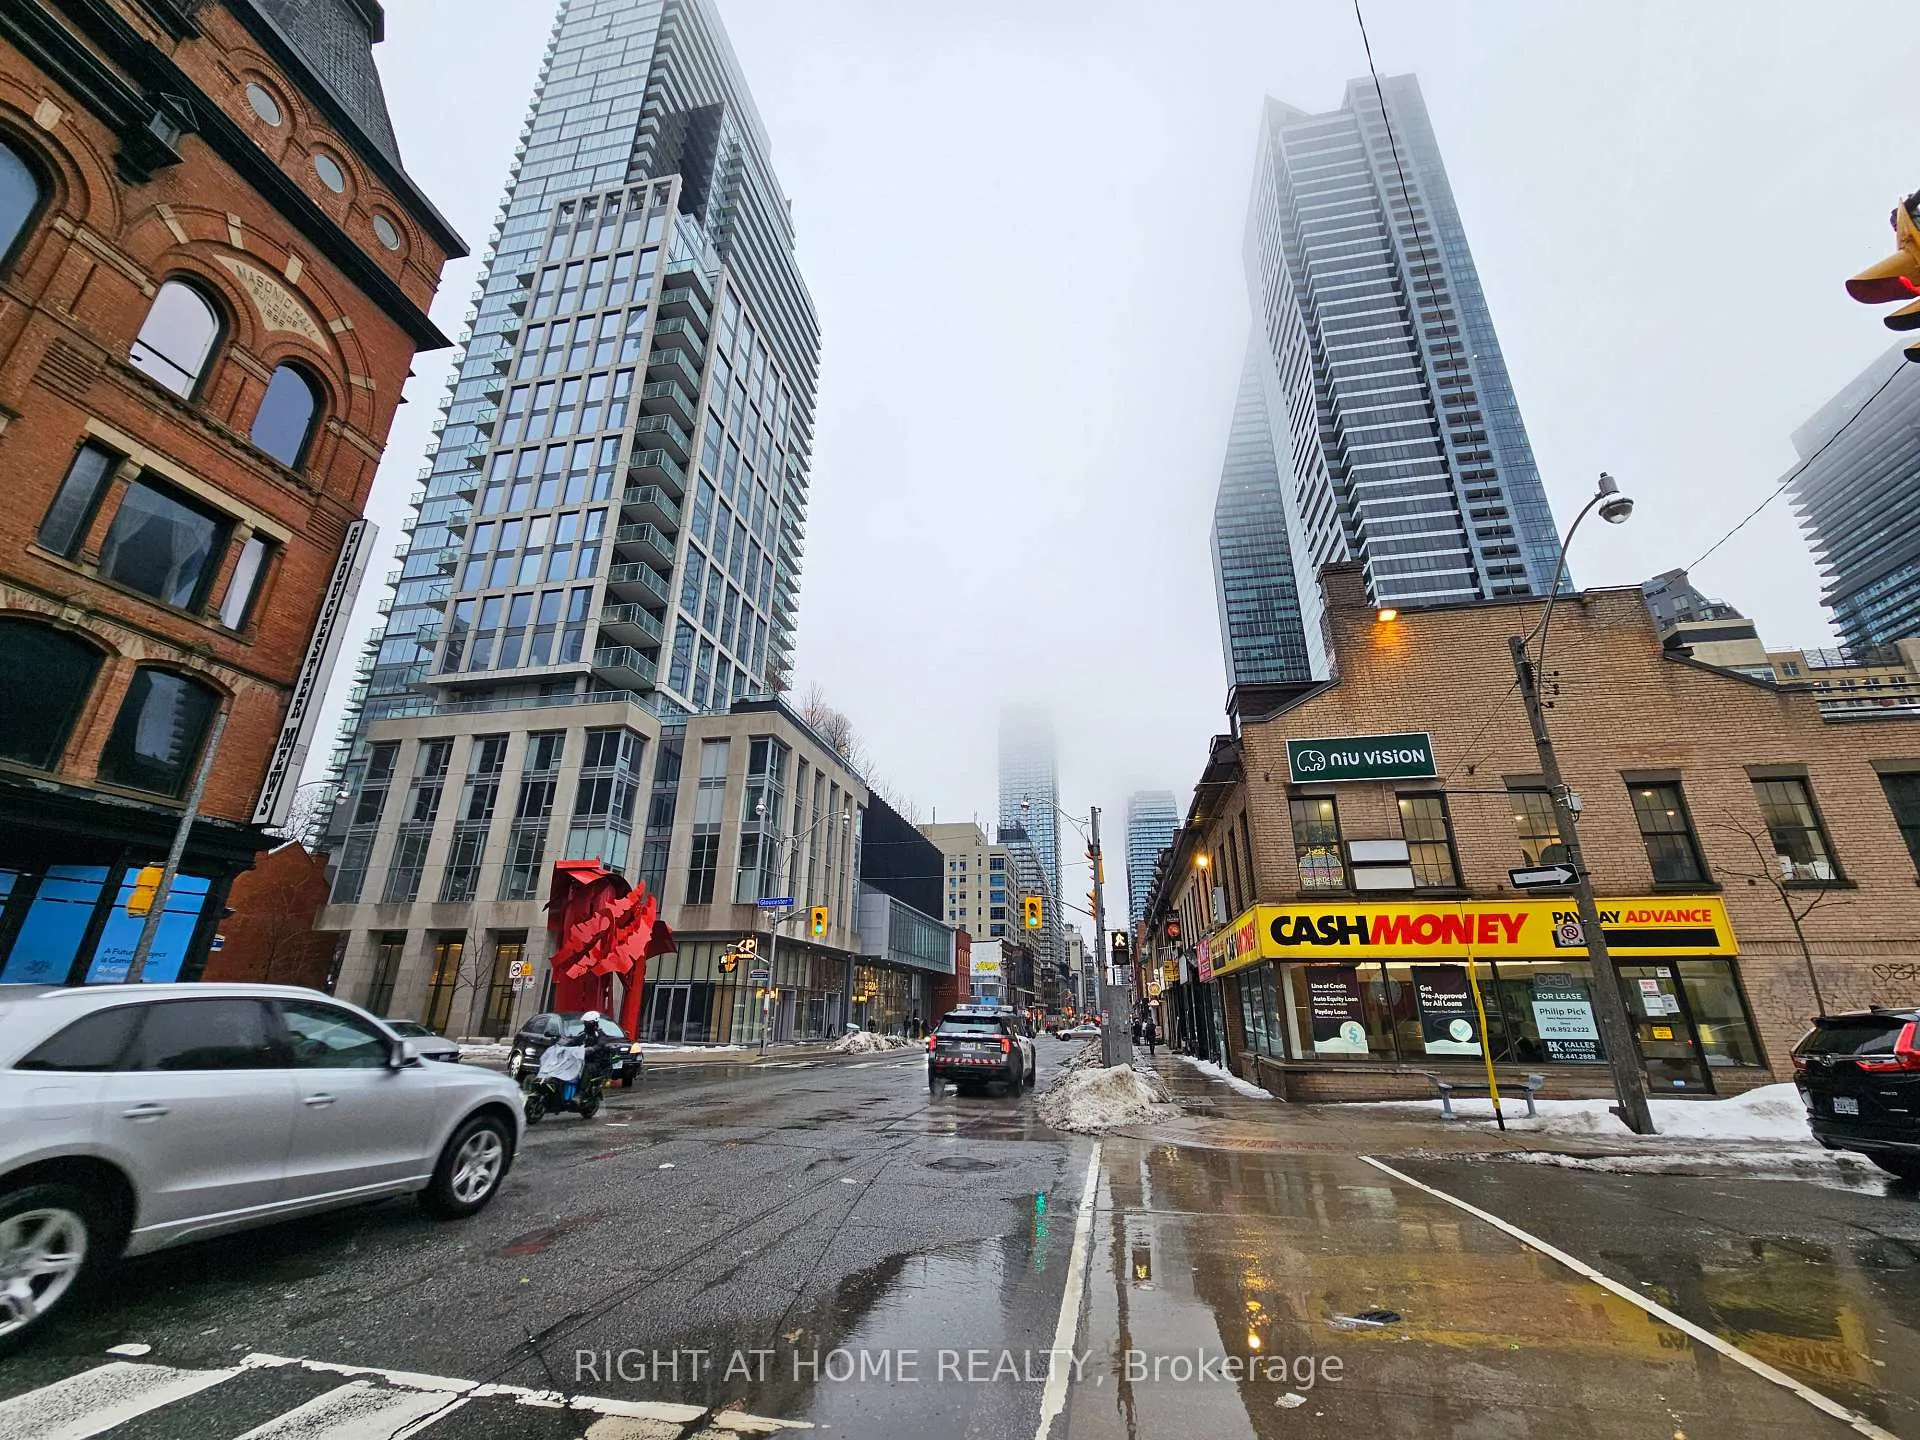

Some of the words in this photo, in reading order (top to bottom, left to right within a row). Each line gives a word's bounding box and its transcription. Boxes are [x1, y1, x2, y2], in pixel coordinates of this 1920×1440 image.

[235, 264, 293, 310] MASONIC
[293, 307, 317, 338] HALL
[258, 726, 298, 817] MEWS
[760, 898, 788, 906] Gloucester
[1551, 910, 1621, 925] PAYAY
[1625, 908, 1713, 924] ADVANCE
[1537, 975, 1571, 985] OPEN
[1421, 992, 1467, 1000] Pre-Approved
[1539, 1008, 1565, 1017] Philip
